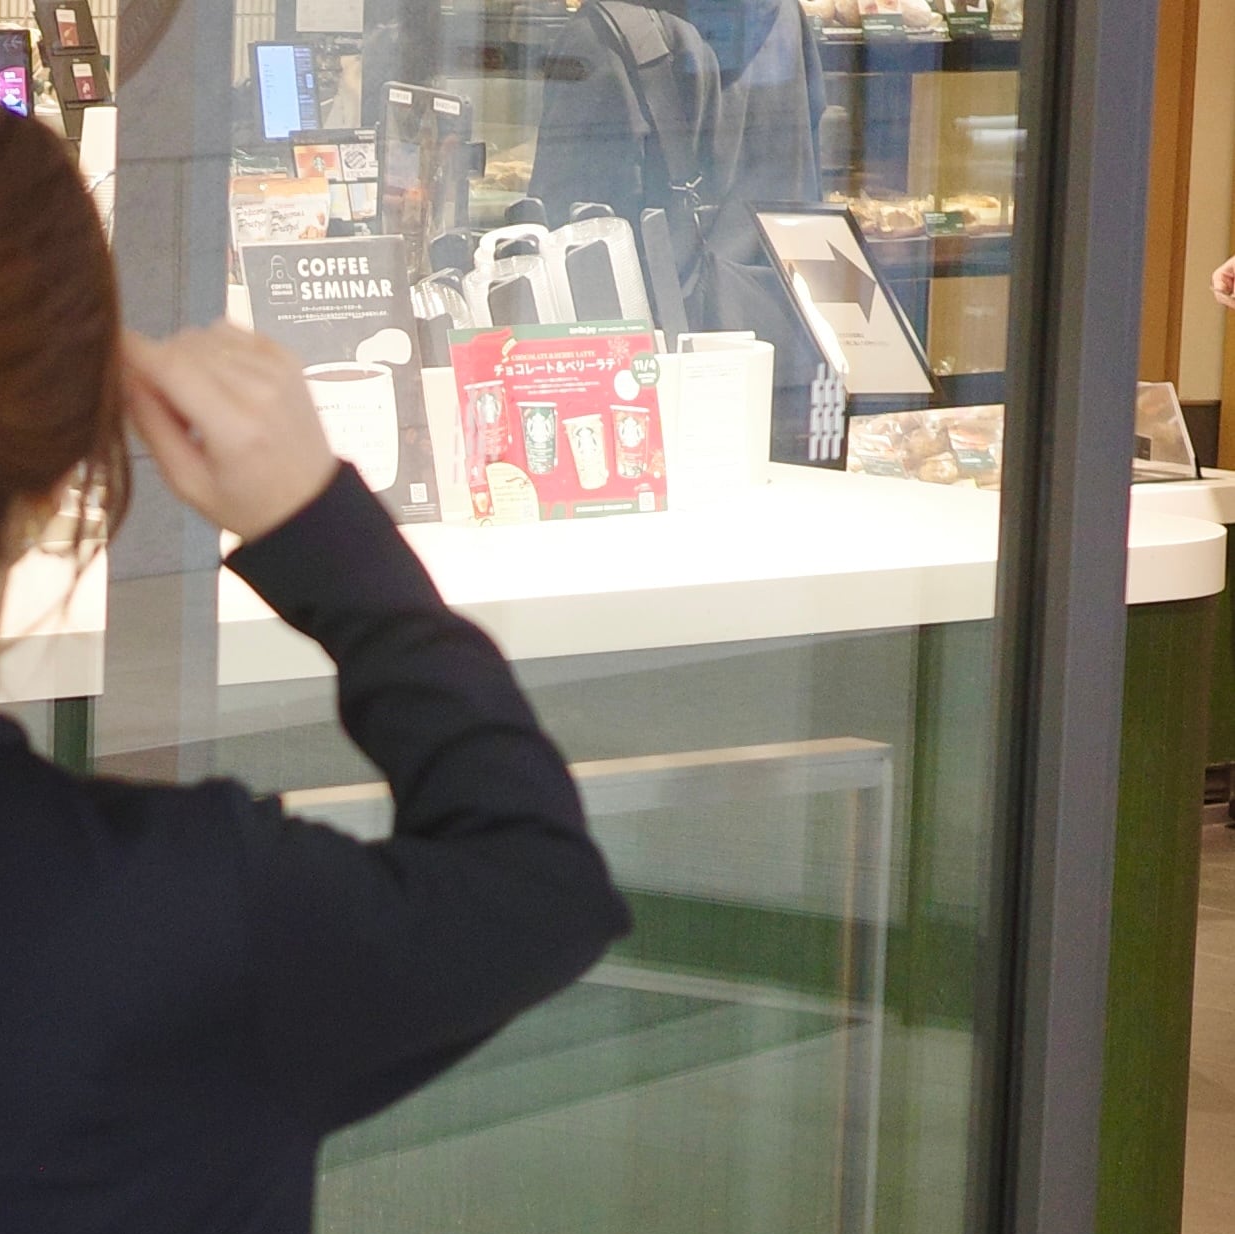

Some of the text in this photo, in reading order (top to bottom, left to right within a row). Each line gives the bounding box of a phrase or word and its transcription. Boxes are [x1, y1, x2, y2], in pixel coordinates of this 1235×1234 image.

[297, 256, 370, 278] COFFEE
[300, 279, 394, 300] SEMINAR
[633, 359, 657, 372] 11/4
